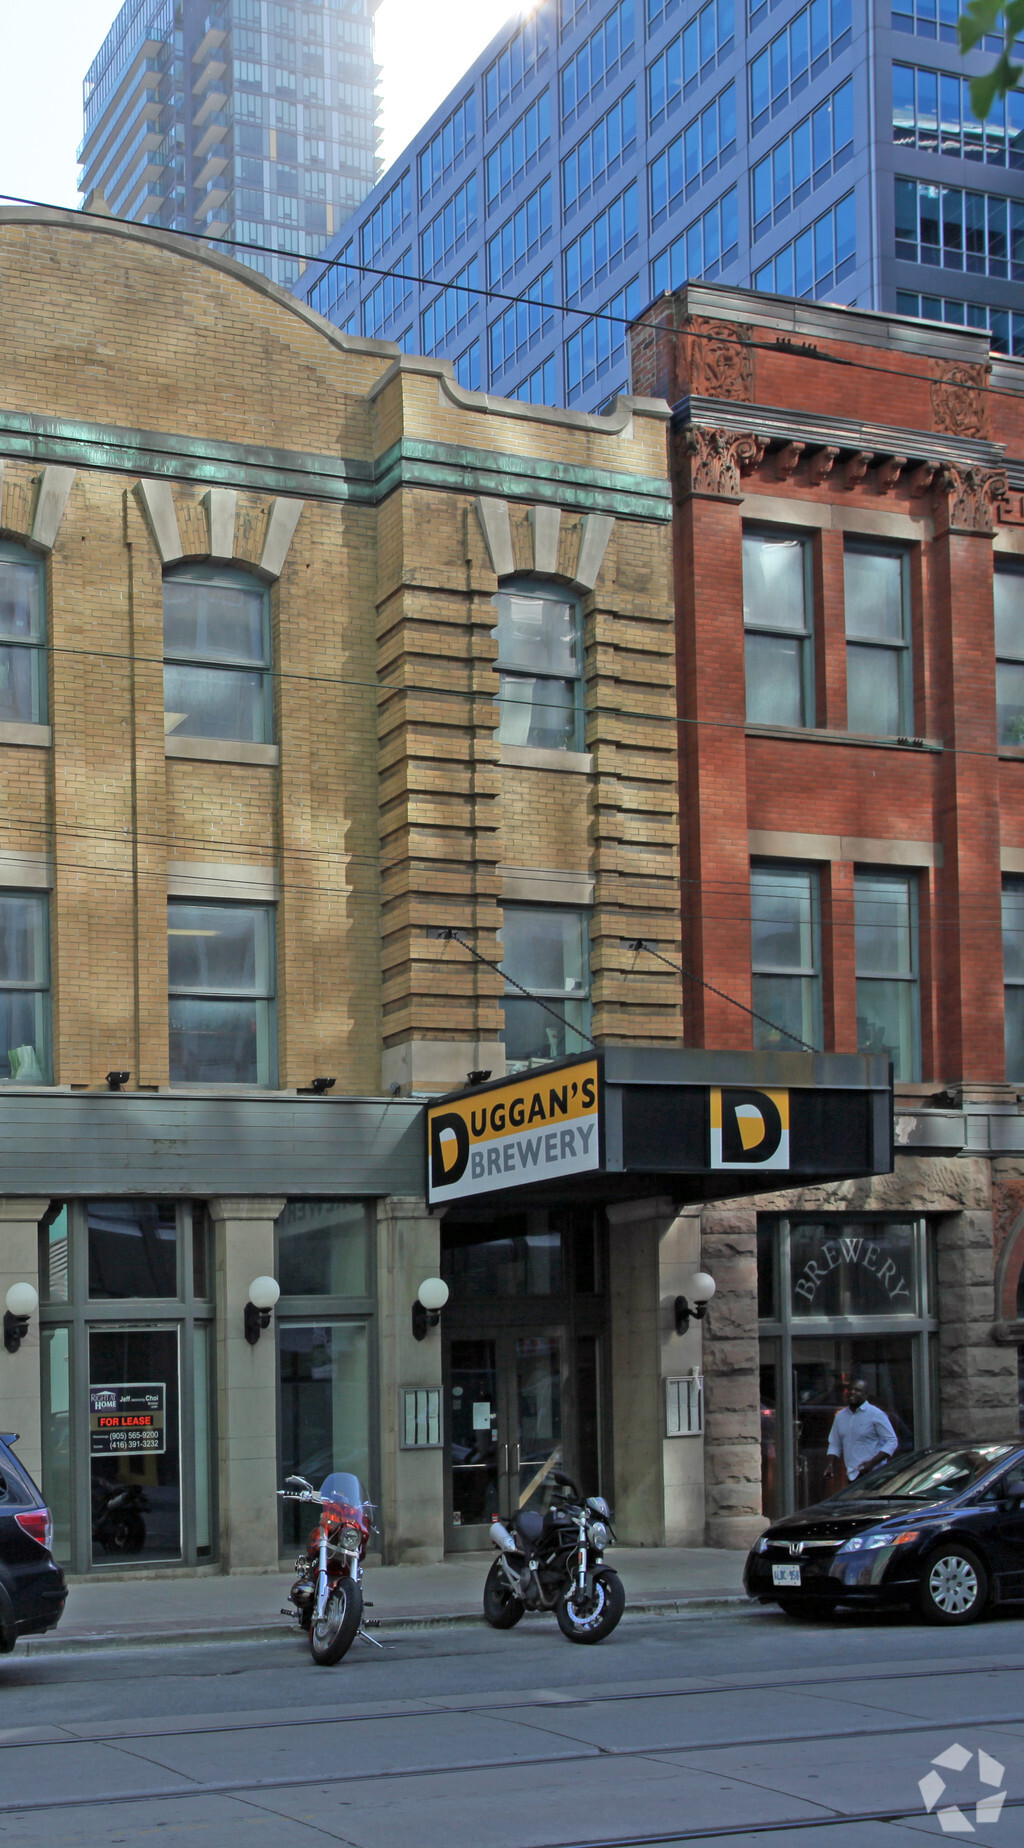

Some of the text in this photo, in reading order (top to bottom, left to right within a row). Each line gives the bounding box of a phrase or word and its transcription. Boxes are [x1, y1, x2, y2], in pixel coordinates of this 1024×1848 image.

[721, 1088, 782, 1163] D
[431, 1078, 596, 1189] DUGGAN'S
[471, 1123, 595, 1180] BREWERY
[795, 1238, 910, 1302] BREWERY
[120, 1395, 131, 1403] Jeff
[145, 1394, 159, 1402] Choi
[95, 1400, 117, 1410] HOME
[100, 1416, 151, 1427] FOR LEASE
[109, 1432, 127, 1440] (905)
[128, 1431, 159, 1439] 565-9200
[109, 1441, 127, 1450] (416)
[128, 1440, 159, 1448] 391-3232
